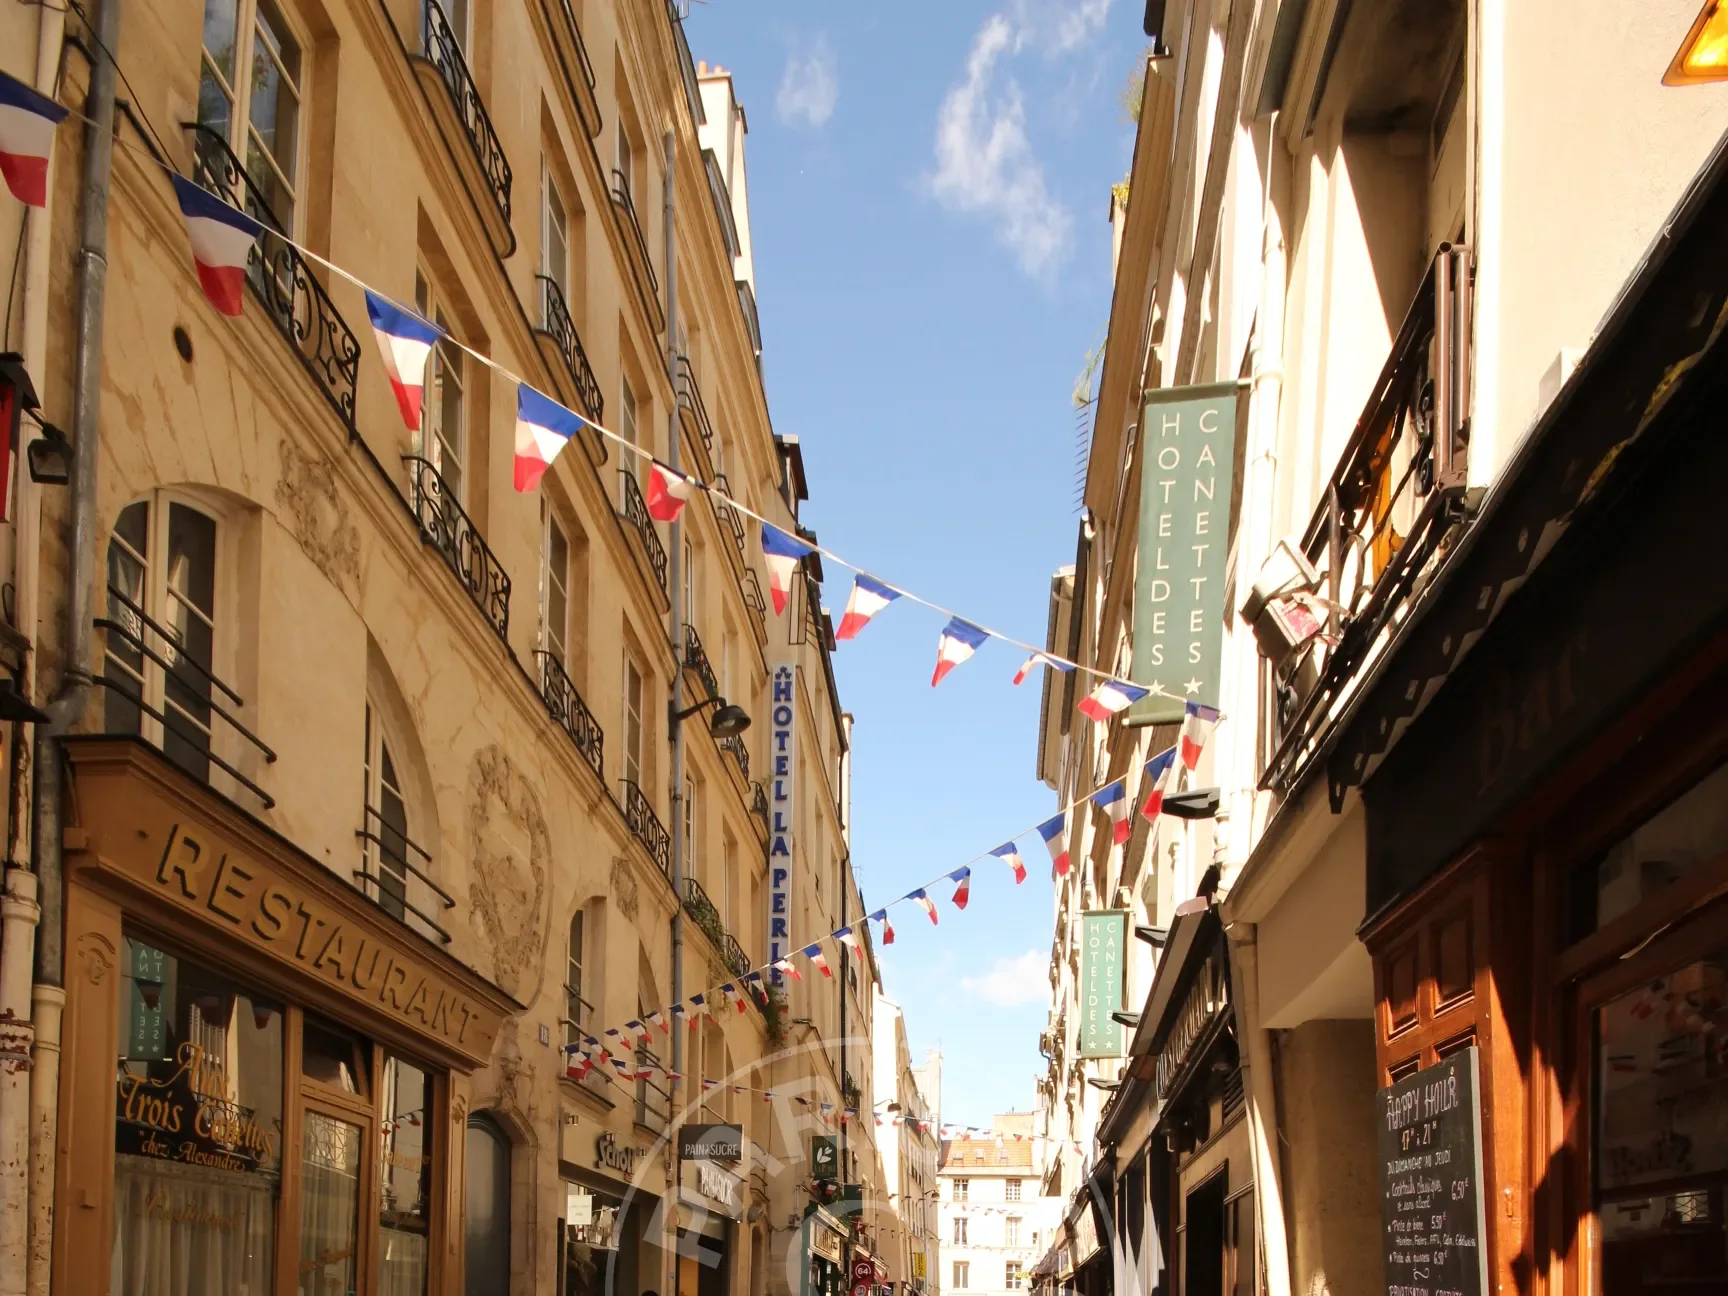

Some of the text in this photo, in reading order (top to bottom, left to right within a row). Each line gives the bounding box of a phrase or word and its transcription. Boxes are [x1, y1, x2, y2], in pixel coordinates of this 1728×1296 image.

[1188, 409, 1218, 664] CANETTES
[770, 680, 793, 989] HOTEL LA PERLE
[156, 823, 480, 1044] RESTAURANT
[1105, 921, 1118, 1036] CANETTES
[541, 1026, 548, 1044] 18
[119, 1072, 184, 1134] Trois
[151, 1041, 236, 1104] Aux
[1386, 1076, 1459, 1131] HAPPY HOUR
[857, 1267, 869, 1276] 64
